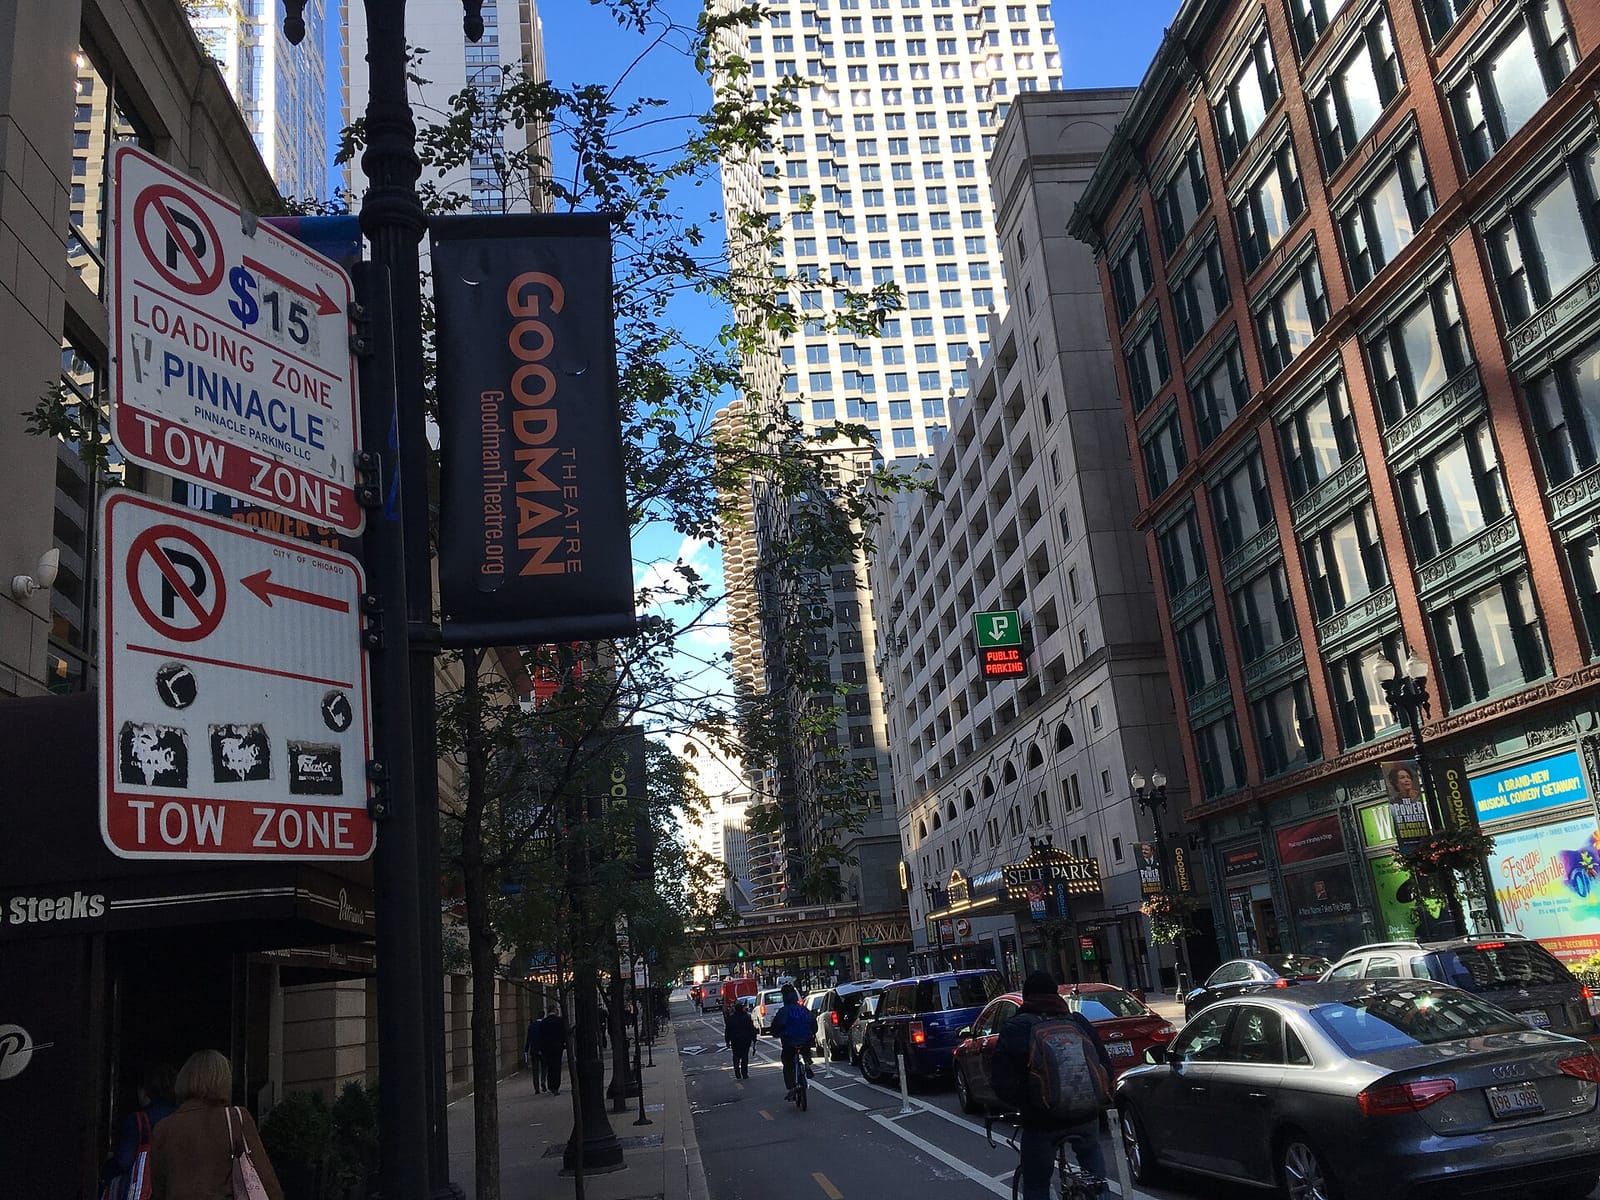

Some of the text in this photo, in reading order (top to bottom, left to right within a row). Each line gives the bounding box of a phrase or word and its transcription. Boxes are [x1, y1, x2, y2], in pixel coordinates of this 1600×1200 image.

[268, 237, 284, 249] CITY
[304, 258, 334, 278] CHICAGO
[228, 264, 310, 345] $15
[133, 295, 333, 409] LOADING ZONE
[163, 351, 325, 451] PINNACLE
[194, 406, 311, 461] PINNACLE PARKING LLC
[507, 271, 565, 576] GOODMAN
[135, 414, 344, 522] TOW ZONE
[480, 390, 505, 576] GoodmanTheatre.org
[560, 447, 582, 573] THEATRE
[273, 549, 290, 559] CITY
[312, 560, 344, 575] CHICAGO
[986, 662, 1023, 674] PARKING
[987, 650, 1019, 661] PUBLIC
[1478, 794, 1510, 812] MUSICAL
[1510, 787, 1541, 804] COMEDY
[1497, 769, 1550, 793] A BRAND-NEW
[127, 801, 354, 849] TOW ZONE
[1393, 801, 1425, 816] POWER
[1051, 863, 1092, 880] PARK
[1501, 849, 1540, 889] Escape
[10, 891, 105, 924] Steaks
